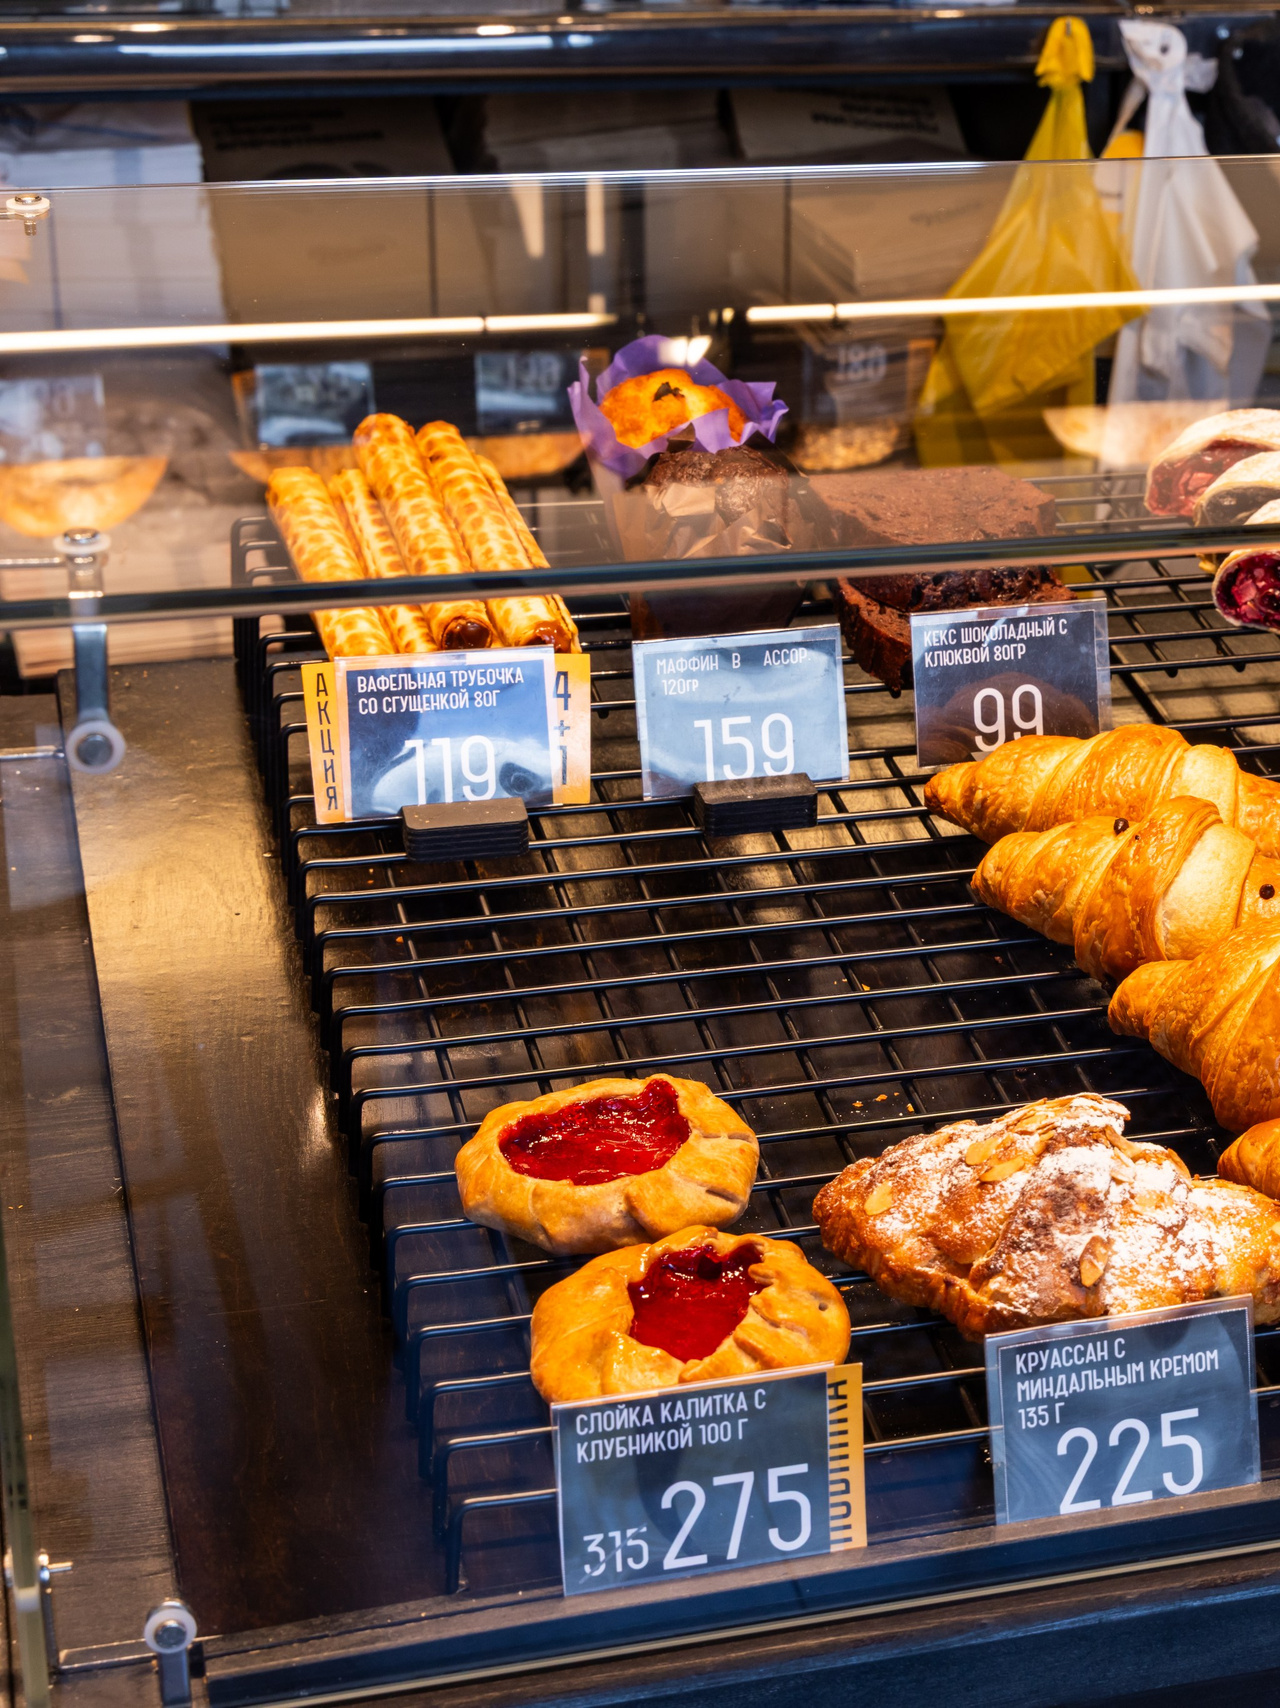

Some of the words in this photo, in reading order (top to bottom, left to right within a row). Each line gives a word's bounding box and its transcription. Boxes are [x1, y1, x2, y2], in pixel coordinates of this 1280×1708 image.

[923, 629, 957, 647] КЕКС
[961, 617, 1056, 645] ШОКОЛАДНЫЙ
[1058, 618, 1068, 635] С
[924, 645, 990, 668] КЛЮКВОЙ
[993, 643, 1026, 662] 80ГР
[357, 671, 447, 693] ВАФЕЛЬНАЯ
[450, 667, 524, 688] ТРУБОЧКА
[656, 654, 719, 676] МАФФИН
[732, 653, 741, 669] В
[763, 647, 812, 668] АССОР.
[358, 697, 378, 715] СО
[382, 690, 470, 714] СГУЩЕНКОЙ
[474, 689, 501, 708] 80Г
[973, 683, 1044, 752] 99
[315, 672, 339, 811] АКЦИЯ
[693, 712, 795, 782] 159
[404, 735, 497, 806] 119
[1015, 1339, 1109, 1375] КРУАССАН
[1114, 1337, 1126, 1359] С
[1017, 1361, 1145, 1403] МИНДАЛЬНЫМ
[1150, 1349, 1220, 1381] КРЕМОМ
[575, 1403, 654, 1436] СЛОЙКА
[660, 1391, 749, 1425] КАЛИТКА
[754, 1388, 767, 1410] С
[1018, 1405, 1050, 1430] 135
[1055, 1402, 1065, 1425] Г
[576, 1422, 693, 1464] КЛУБНИКОЙ
[698, 1420, 732, 1446] 100
[738, 1418, 749, 1440] Г
[1056, 1407, 1204, 1515] 225
[583, 1526, 650, 1577] 315
[660, 1462, 812, 1570] 275
